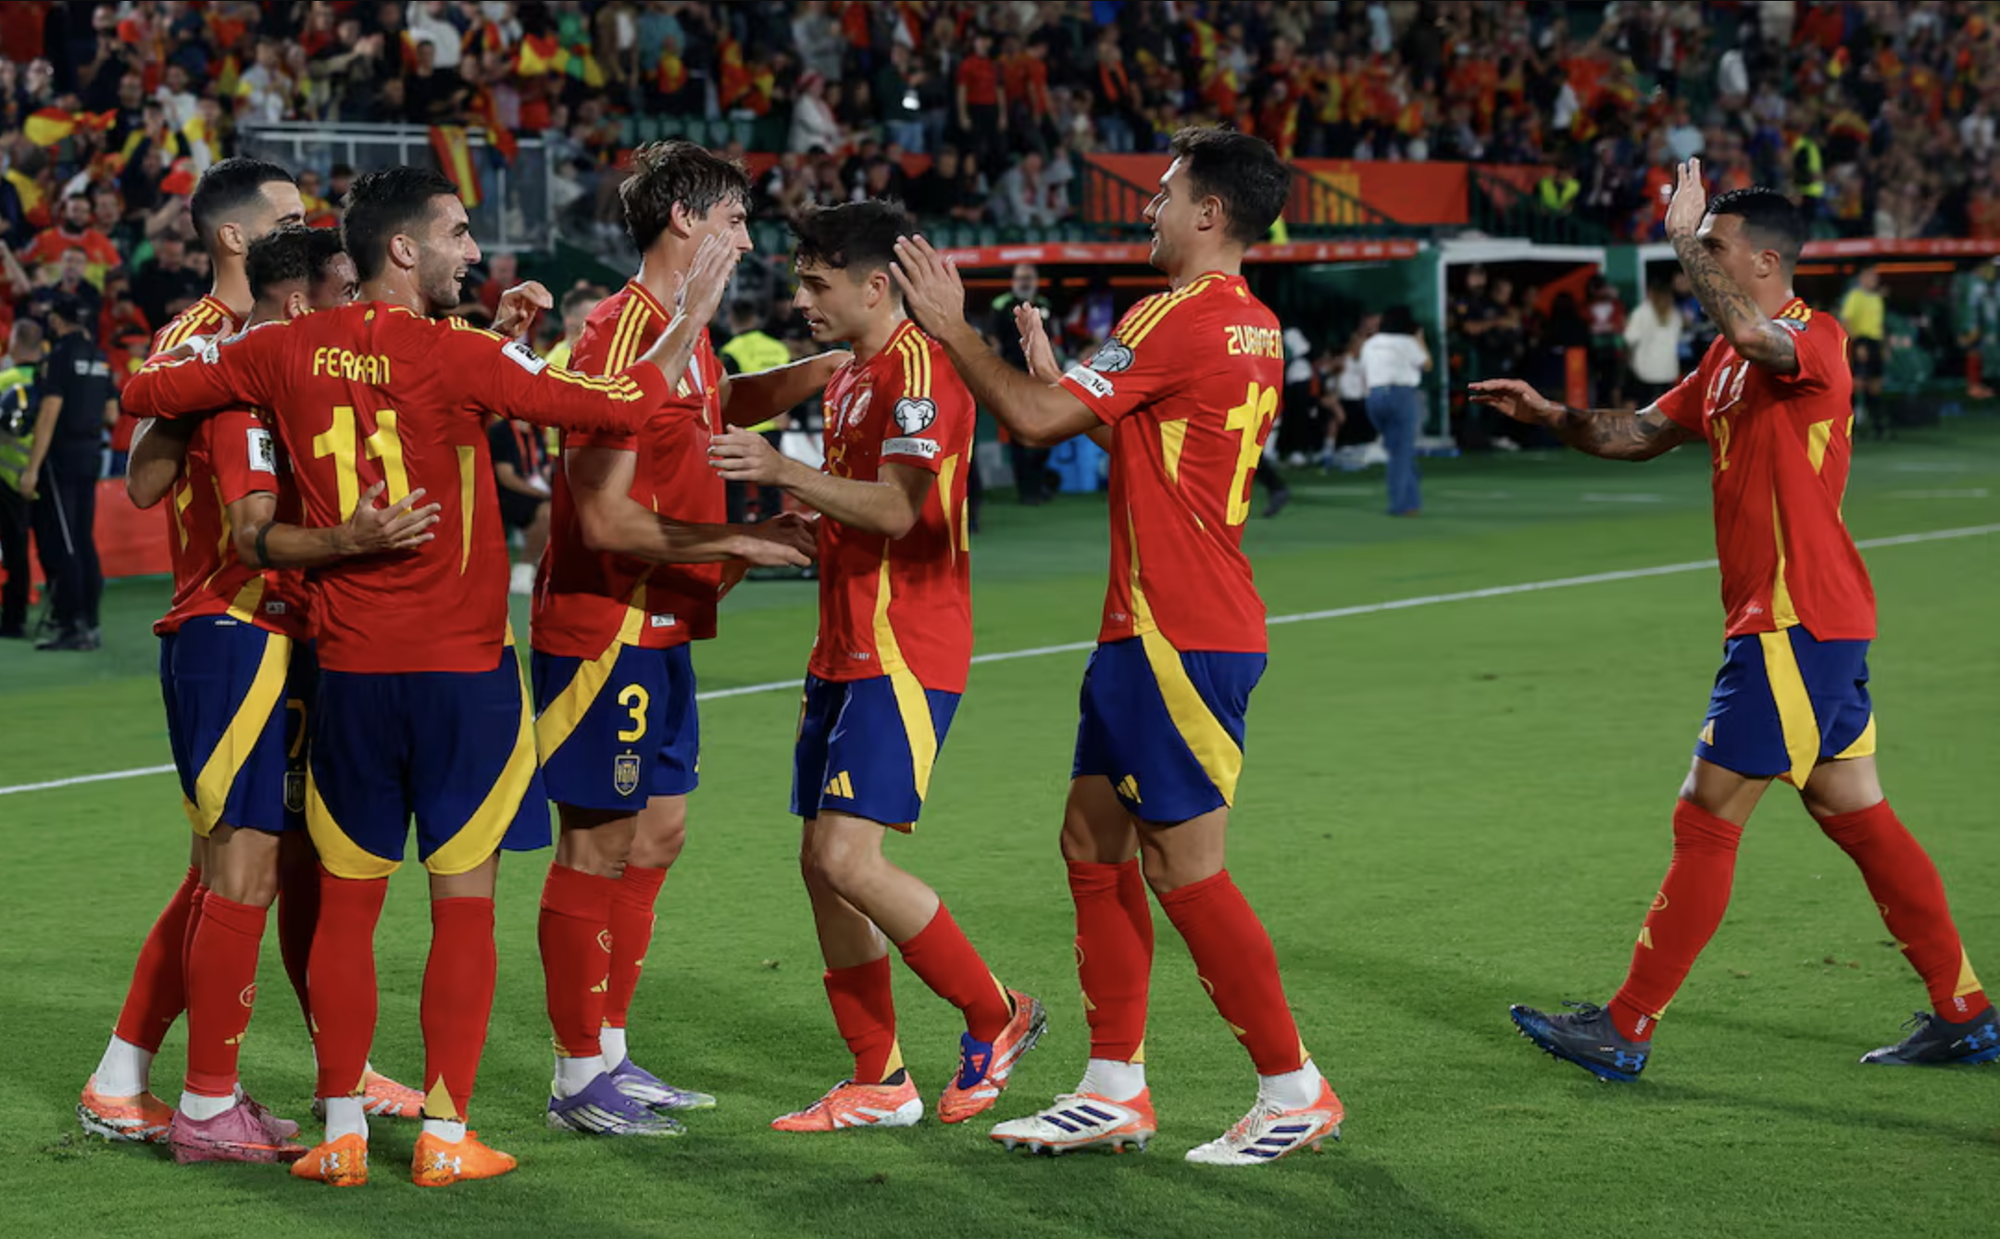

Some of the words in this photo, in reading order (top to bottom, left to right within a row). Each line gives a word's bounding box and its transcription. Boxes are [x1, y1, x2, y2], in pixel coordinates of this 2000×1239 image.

[313, 347, 390, 385] FERRAN
[313, 406, 413, 523] 11
[286, 699, 307, 758] 7
[618, 684, 649, 742] 3
